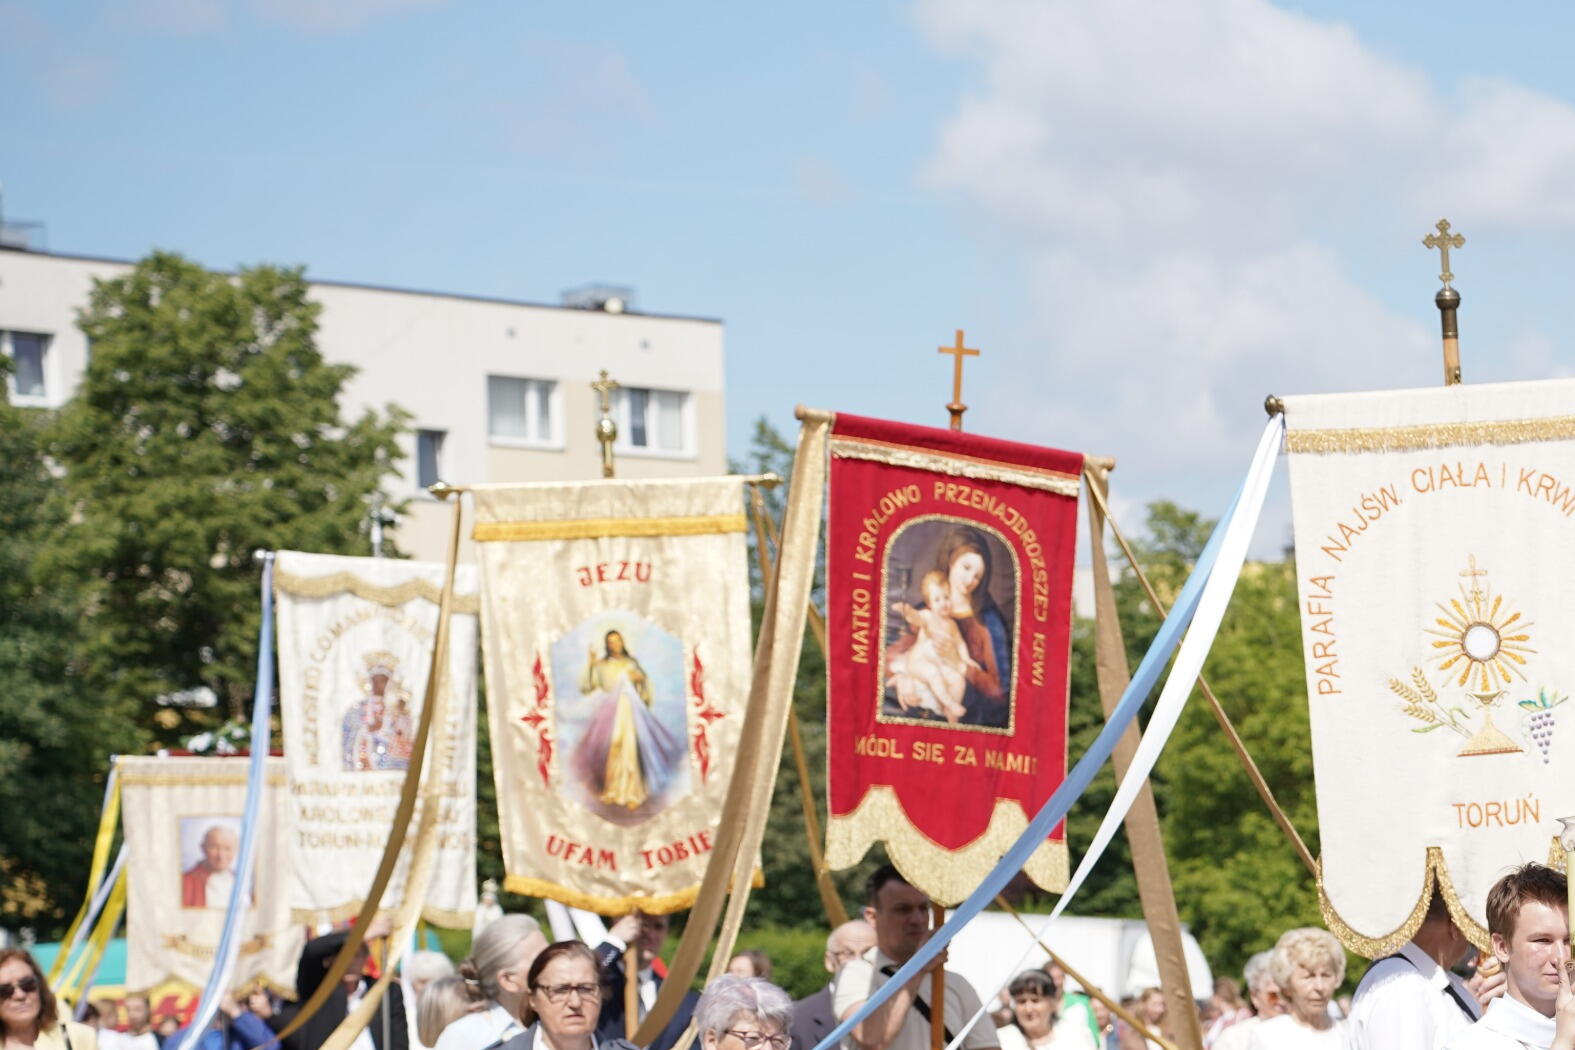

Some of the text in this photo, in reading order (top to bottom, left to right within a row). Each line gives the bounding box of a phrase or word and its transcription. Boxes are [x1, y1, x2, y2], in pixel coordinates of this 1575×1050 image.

[1411, 462, 1491, 493] CIAŁA
[1501, 463, 1506, 488] I
[855, 484, 921, 564] KRÓLOWO
[1321, 483, 1403, 562] NAJŚW.
[577, 560, 652, 587] JEZU
[852, 571, 872, 581] I
[852, 588, 871, 664] MATKO
[1308, 574, 1342, 695] PARAFIA
[1031, 632, 1046, 687] KRWI
[854, 733, 904, 759] MÓDL
[912, 740, 945, 765] SIĘ
[954, 745, 977, 766] ZA
[1452, 792, 1540, 828] TORUŃ
[545, 829, 714, 872] UFAM TOBIE
